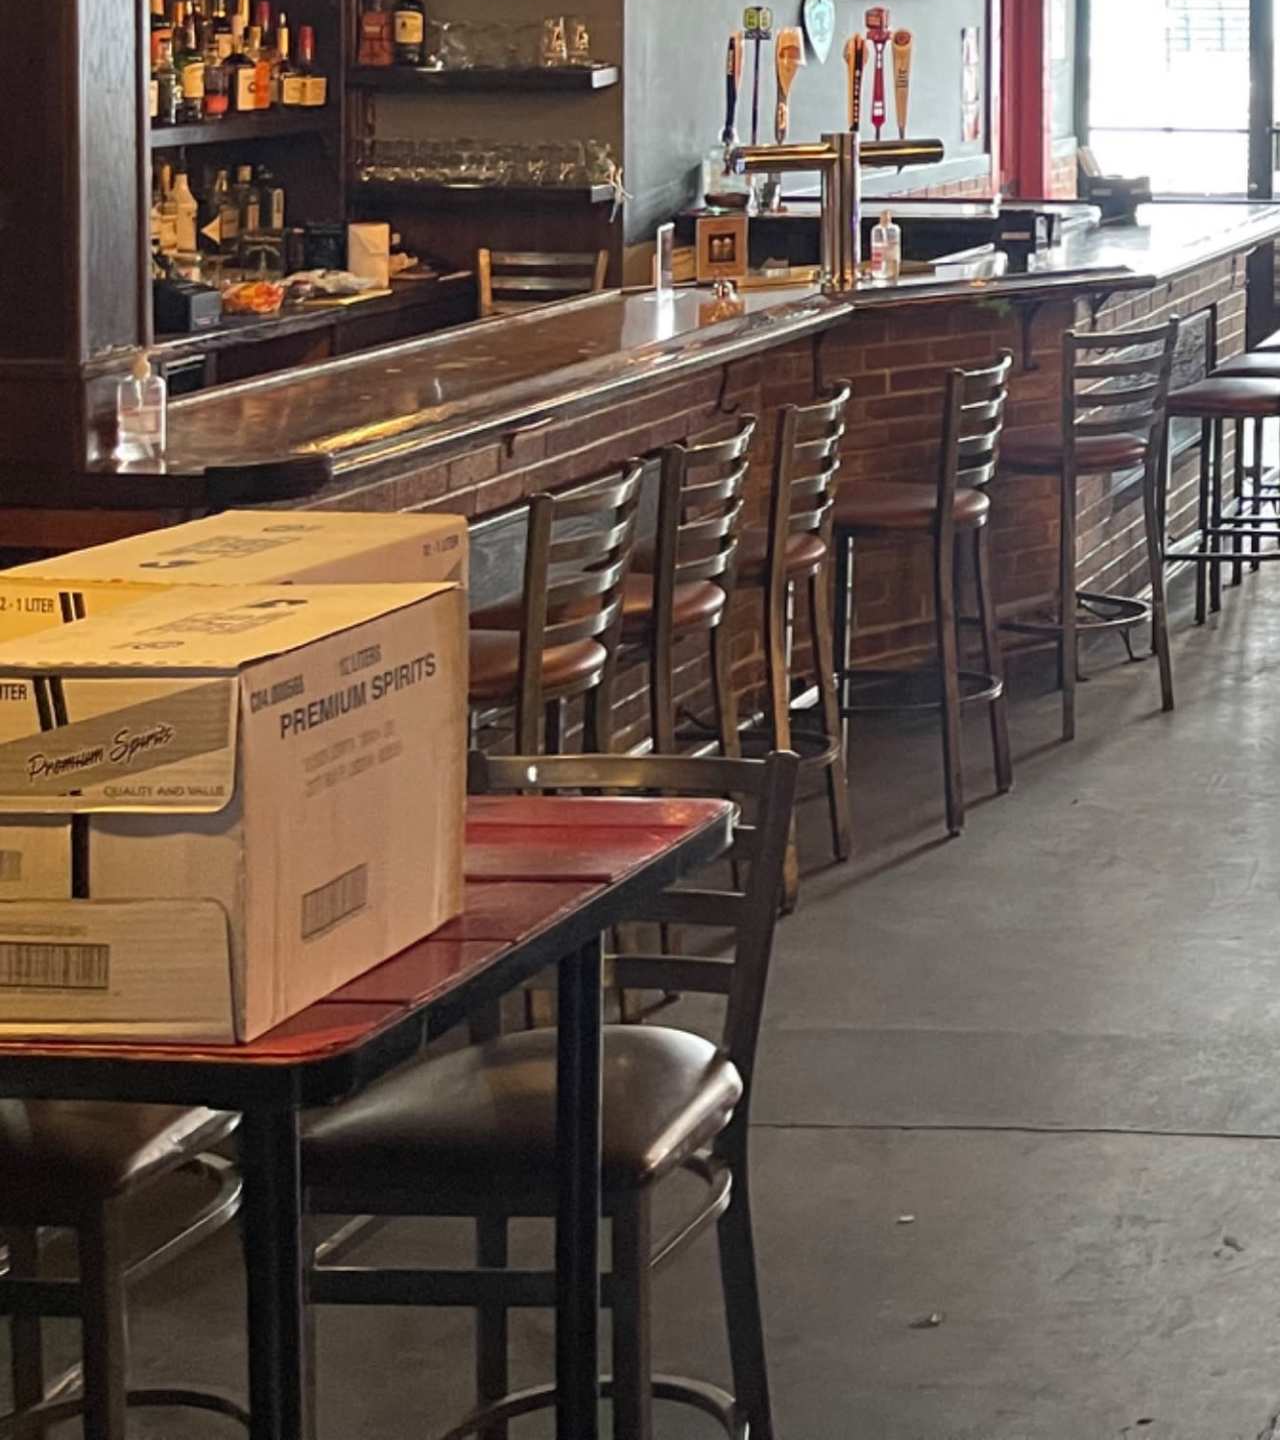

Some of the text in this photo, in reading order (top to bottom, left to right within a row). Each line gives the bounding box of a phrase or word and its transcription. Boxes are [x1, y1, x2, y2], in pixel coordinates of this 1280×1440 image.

[25, 597, 54, 613] LITER
[279, 681, 367, 740] PREMIUM
[371, 652, 437, 700] SPIRITS
[27, 726, 175, 784] Premium Spirits
[103, 784, 225, 798] QUALITY AND VALUE
